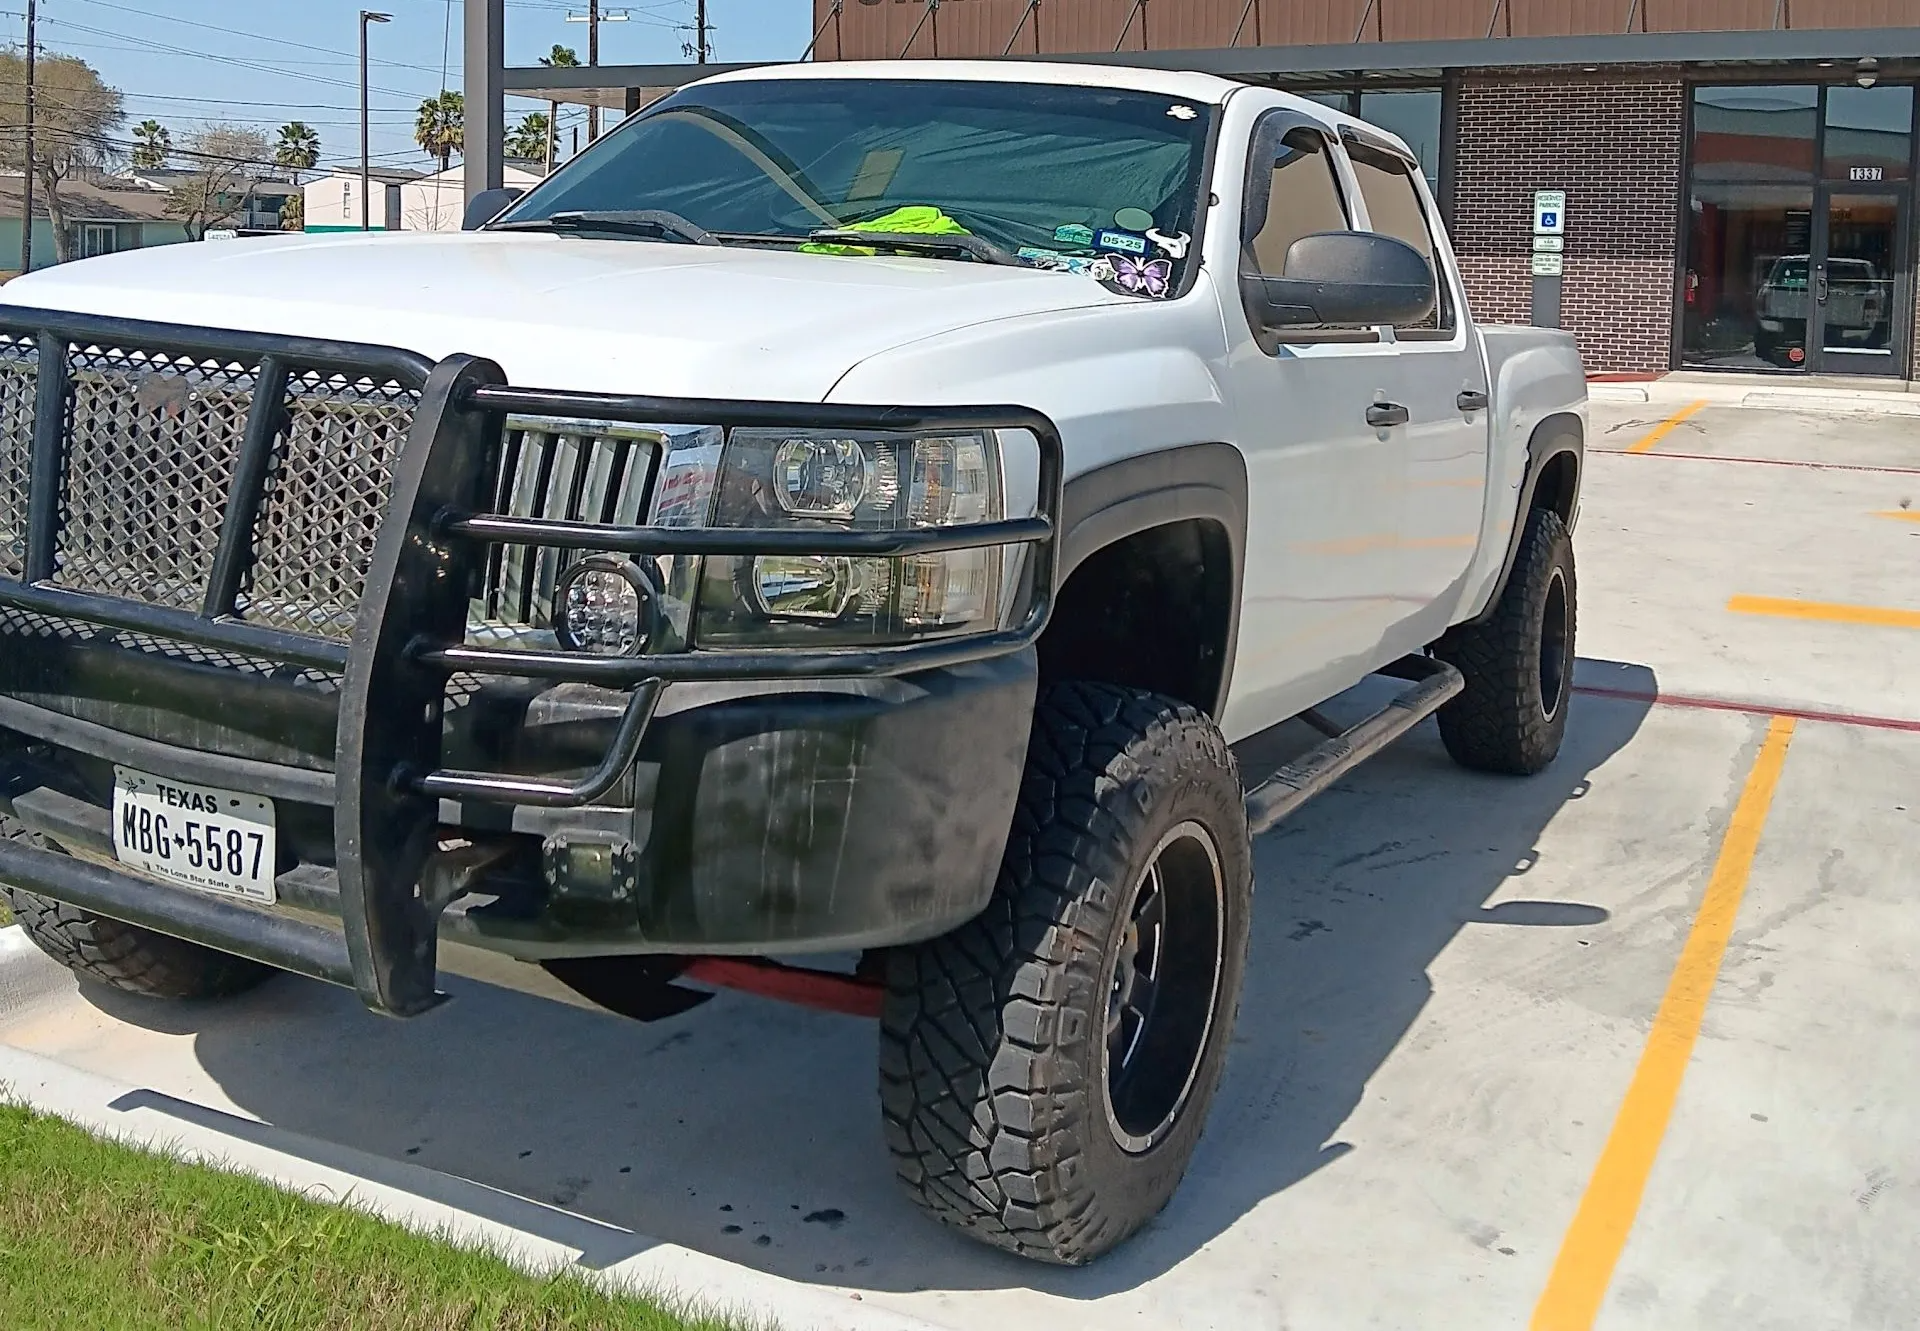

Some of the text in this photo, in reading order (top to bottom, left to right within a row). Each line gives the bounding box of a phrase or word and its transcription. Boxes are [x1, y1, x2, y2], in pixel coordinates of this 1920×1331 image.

[1852, 168, 1881, 180] 1337
[156, 783, 218, 814] TEXAS
[155, 864, 230, 889] The Lone Star State
